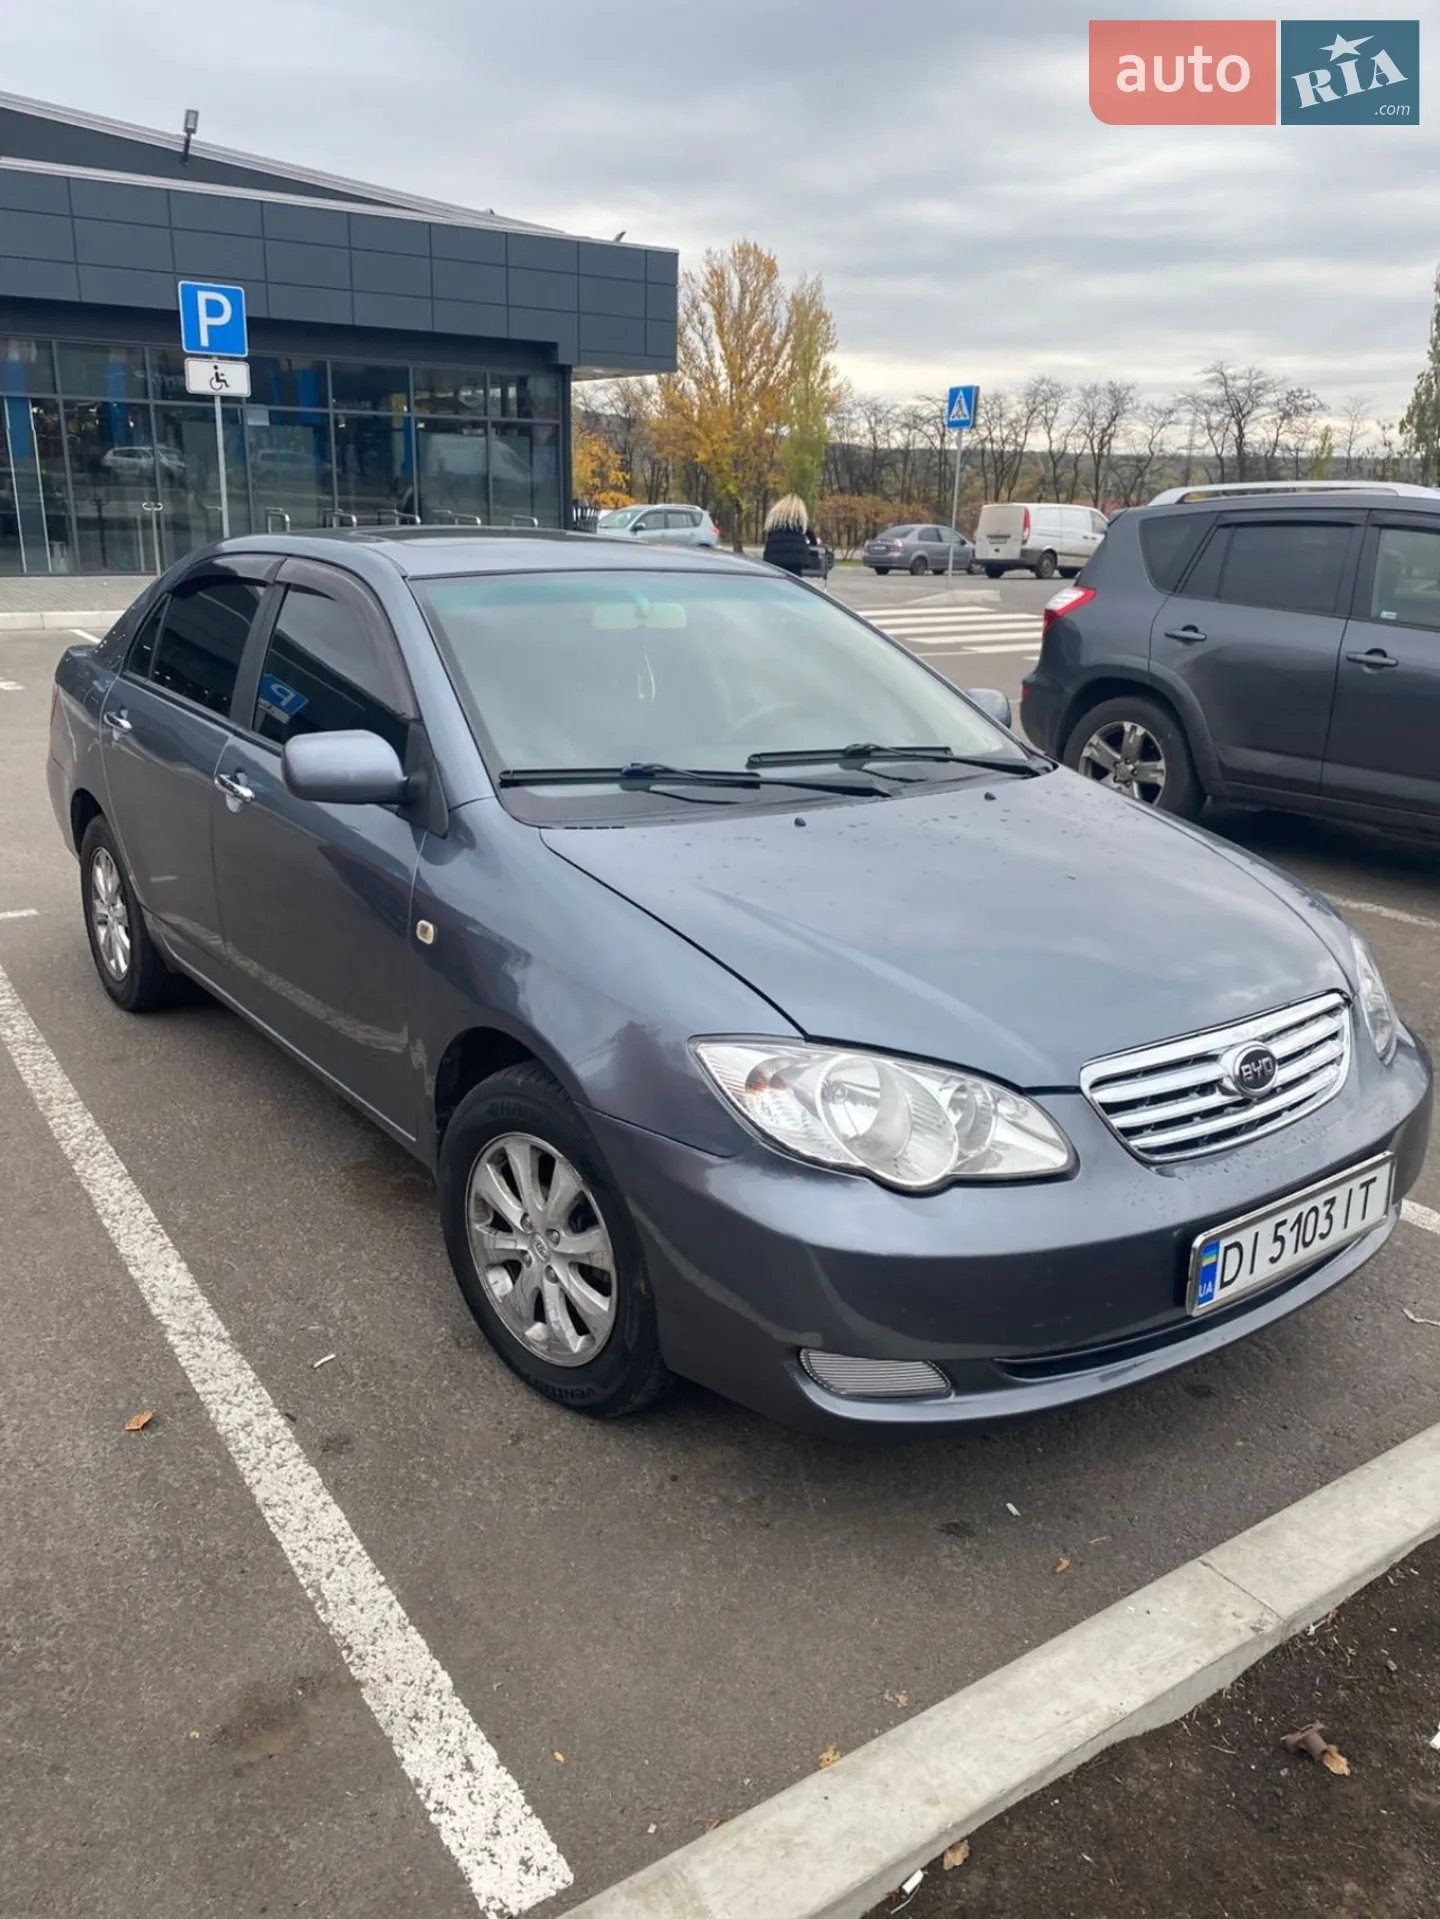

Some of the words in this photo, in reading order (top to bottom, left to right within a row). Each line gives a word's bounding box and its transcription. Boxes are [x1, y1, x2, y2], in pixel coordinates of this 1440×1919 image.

[197, 290, 232, 347] P
[1240, 1056, 1274, 1082] BYD
[1218, 1230, 1260, 1290] DI
[1268, 1194, 1337, 1265] 5103
[1343, 1175, 1378, 1230] IT
[1199, 1281, 1213, 1298] UA
